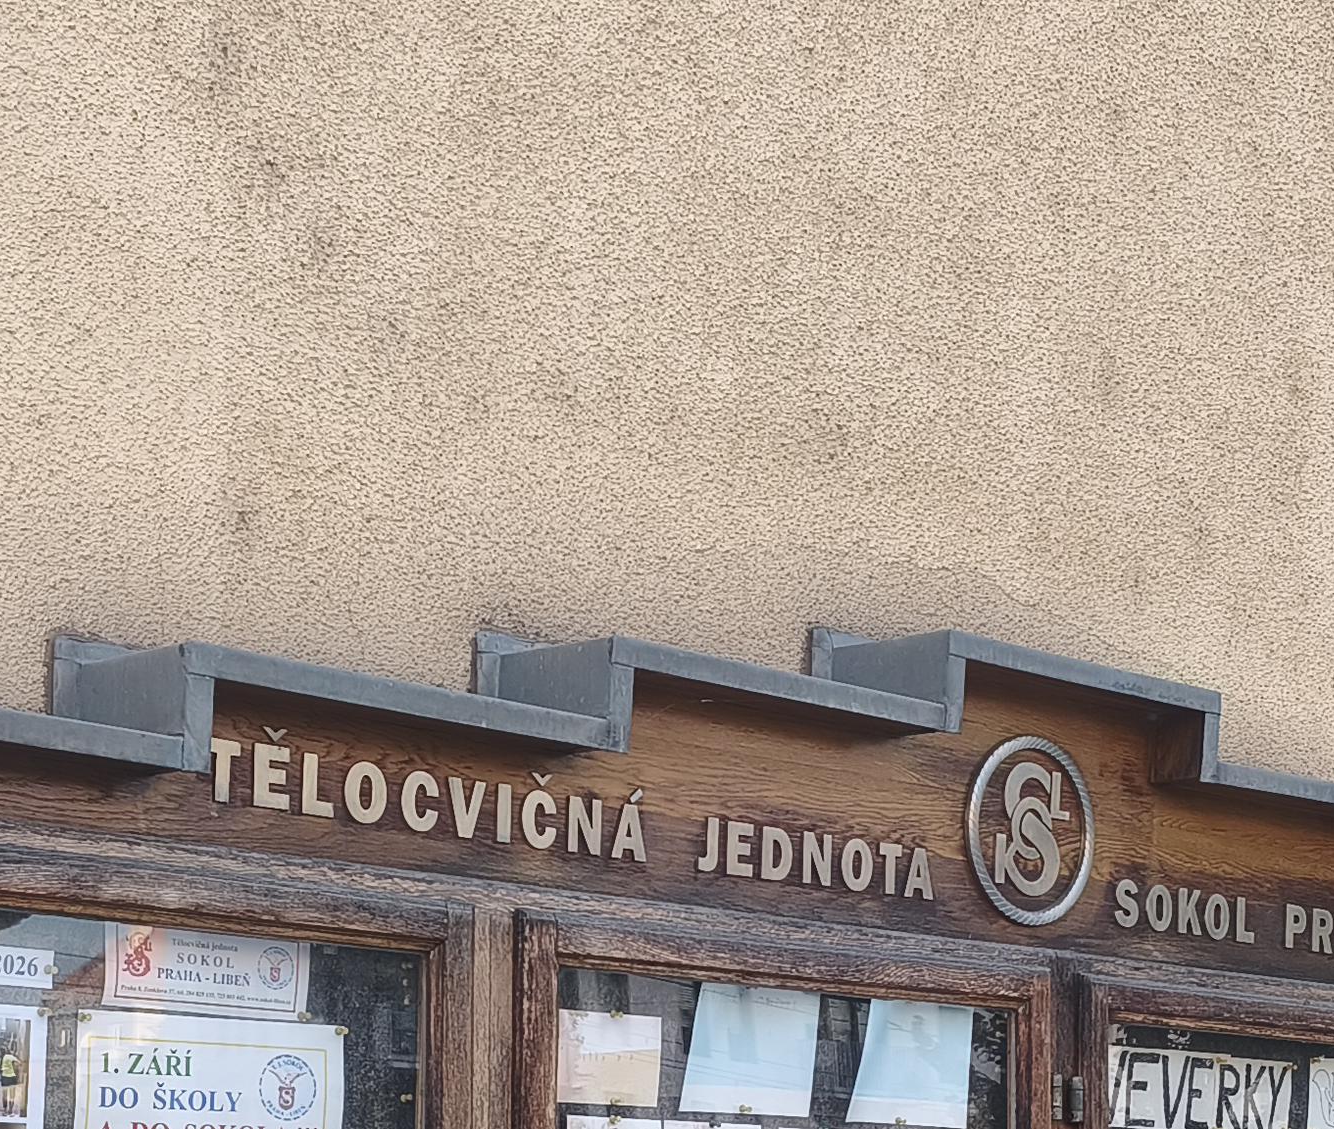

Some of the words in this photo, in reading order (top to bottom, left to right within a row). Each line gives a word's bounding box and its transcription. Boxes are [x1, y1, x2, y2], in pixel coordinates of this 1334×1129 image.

[210, 727, 647, 862] TĚLOCVIČNÁ
[697, 816, 934, 900] JEDNOTA
[1114, 878, 1255, 944] SOKOL
[176, 953, 235, 969] SOKOL
[157, 968, 202, 983] PRAHA
[213, 973, 251, 987] LIBEŇ
[101, 1052, 119, 1073] 1.
[127, 1048, 192, 1077] ZÁŘÍ
[99, 1086, 138, 1109] DO
[153, 1082, 243, 1112] ŠKOLY
